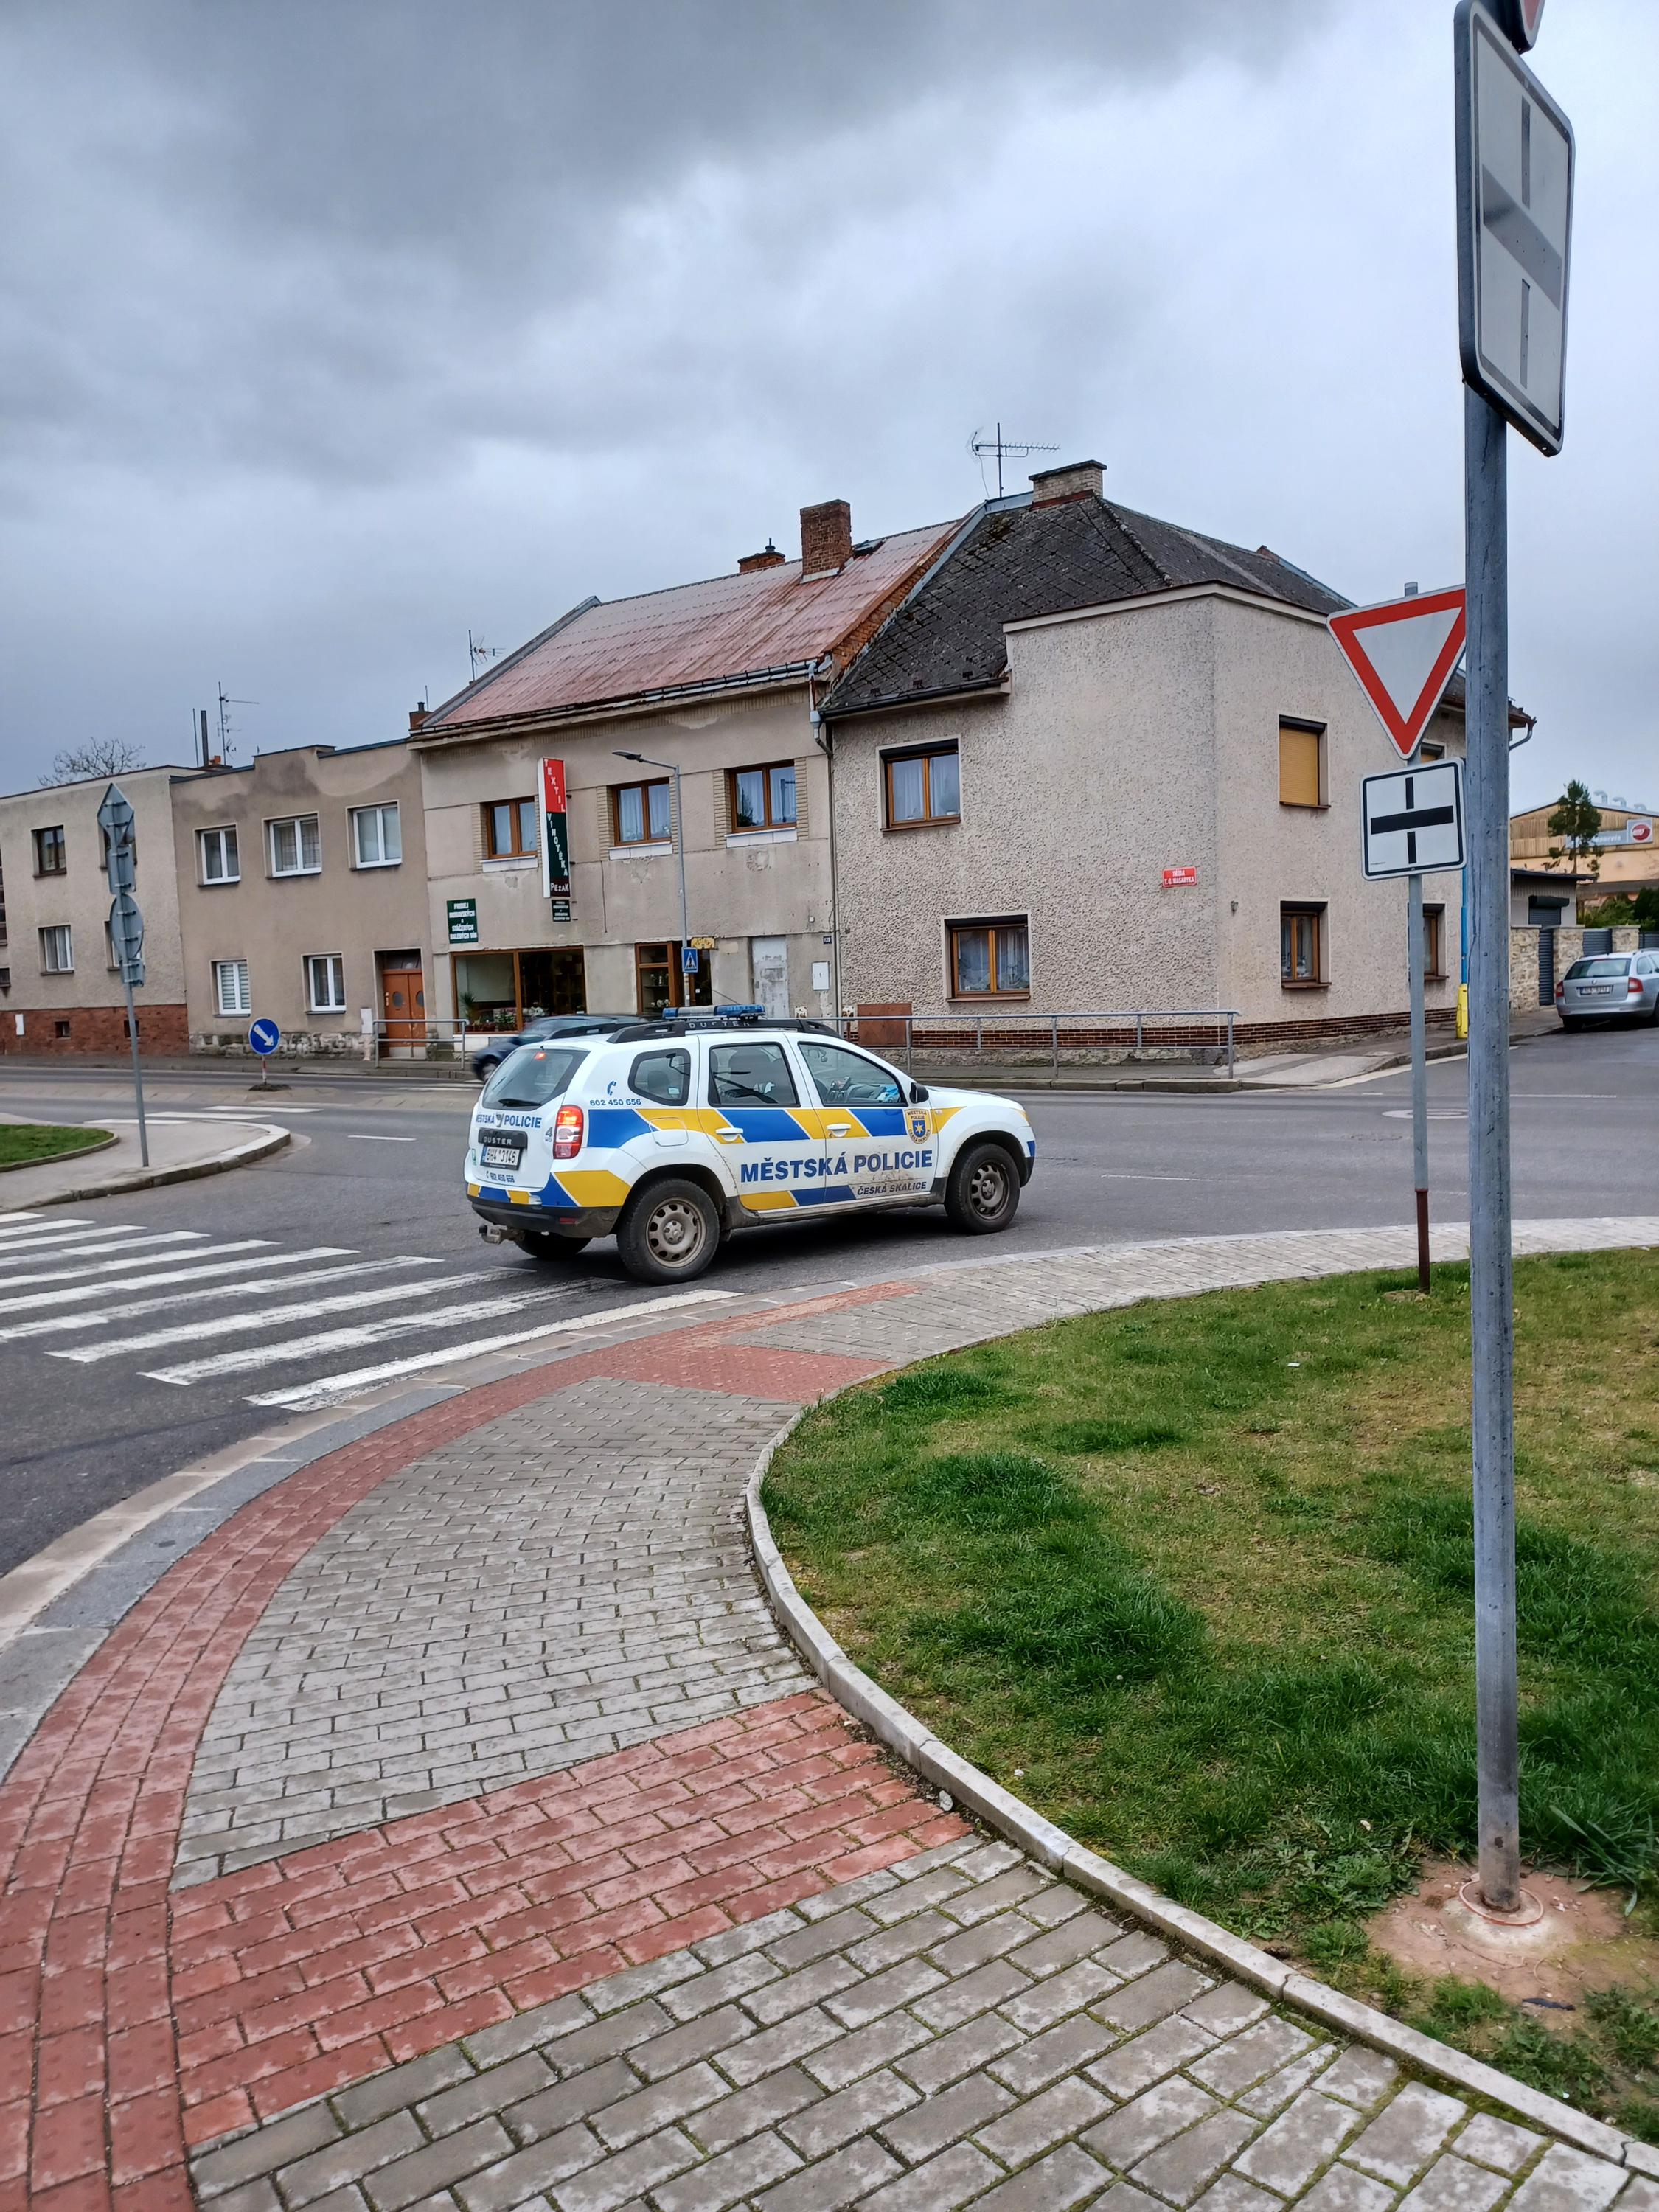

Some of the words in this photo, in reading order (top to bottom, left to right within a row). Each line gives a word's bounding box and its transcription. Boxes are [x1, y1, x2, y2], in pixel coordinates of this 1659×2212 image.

[544, 759, 566, 813] TEXTIL
[504, 1114, 542, 1128] POLICIE
[484, 1136, 512, 1145] DUSTER
[501, 1150, 516, 1164] 3146
[740, 1151, 848, 1183] MĚSTSKÁ
[854, 1150, 933, 1173] POLICIE
[857, 1183, 887, 1195] ČESKÁ
[889, 1181, 927, 1192] SKALICE
